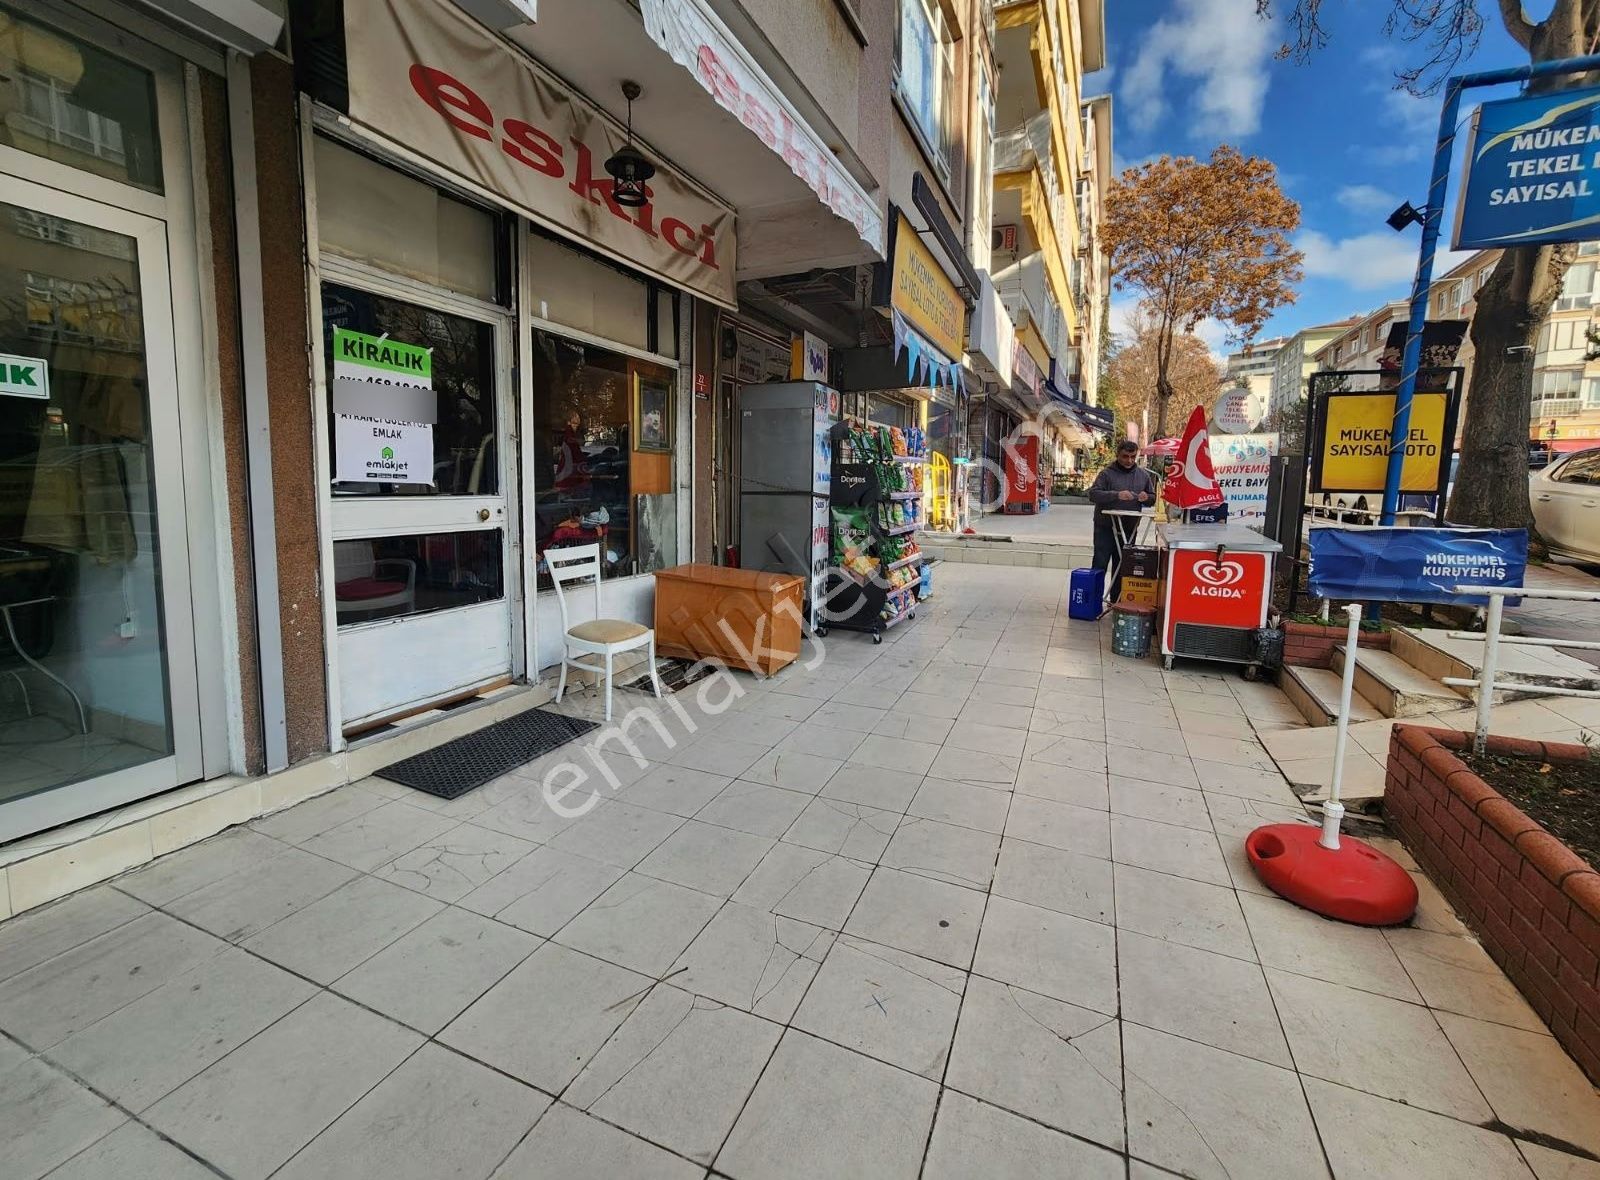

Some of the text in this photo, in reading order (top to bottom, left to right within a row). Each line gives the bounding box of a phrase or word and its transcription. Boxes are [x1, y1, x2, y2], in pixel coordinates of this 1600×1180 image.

[408, 63, 720, 270] eskici
[1507, 154, 1585, 178] TEKEL
[1489, 180, 1593, 206] SAYISAL
[343, 337, 423, 371] KİRALIK
[698, 374, 704, 384] 22
[373, 428, 402, 439] EMLAK
[1340, 427, 1429, 441] MÜKEMEL
[366, 459, 408, 472] emlakjet
[840, 475, 866, 484] Doritos
[1217, 478, 1242, 488] EKEL
[1195, 514, 1215, 522] EFES
[838, 526, 866, 536] Doritos
[1426, 552, 1507, 566] MÜKEMMEL
[1422, 566, 1506, 580] KURUYEMİŞ
